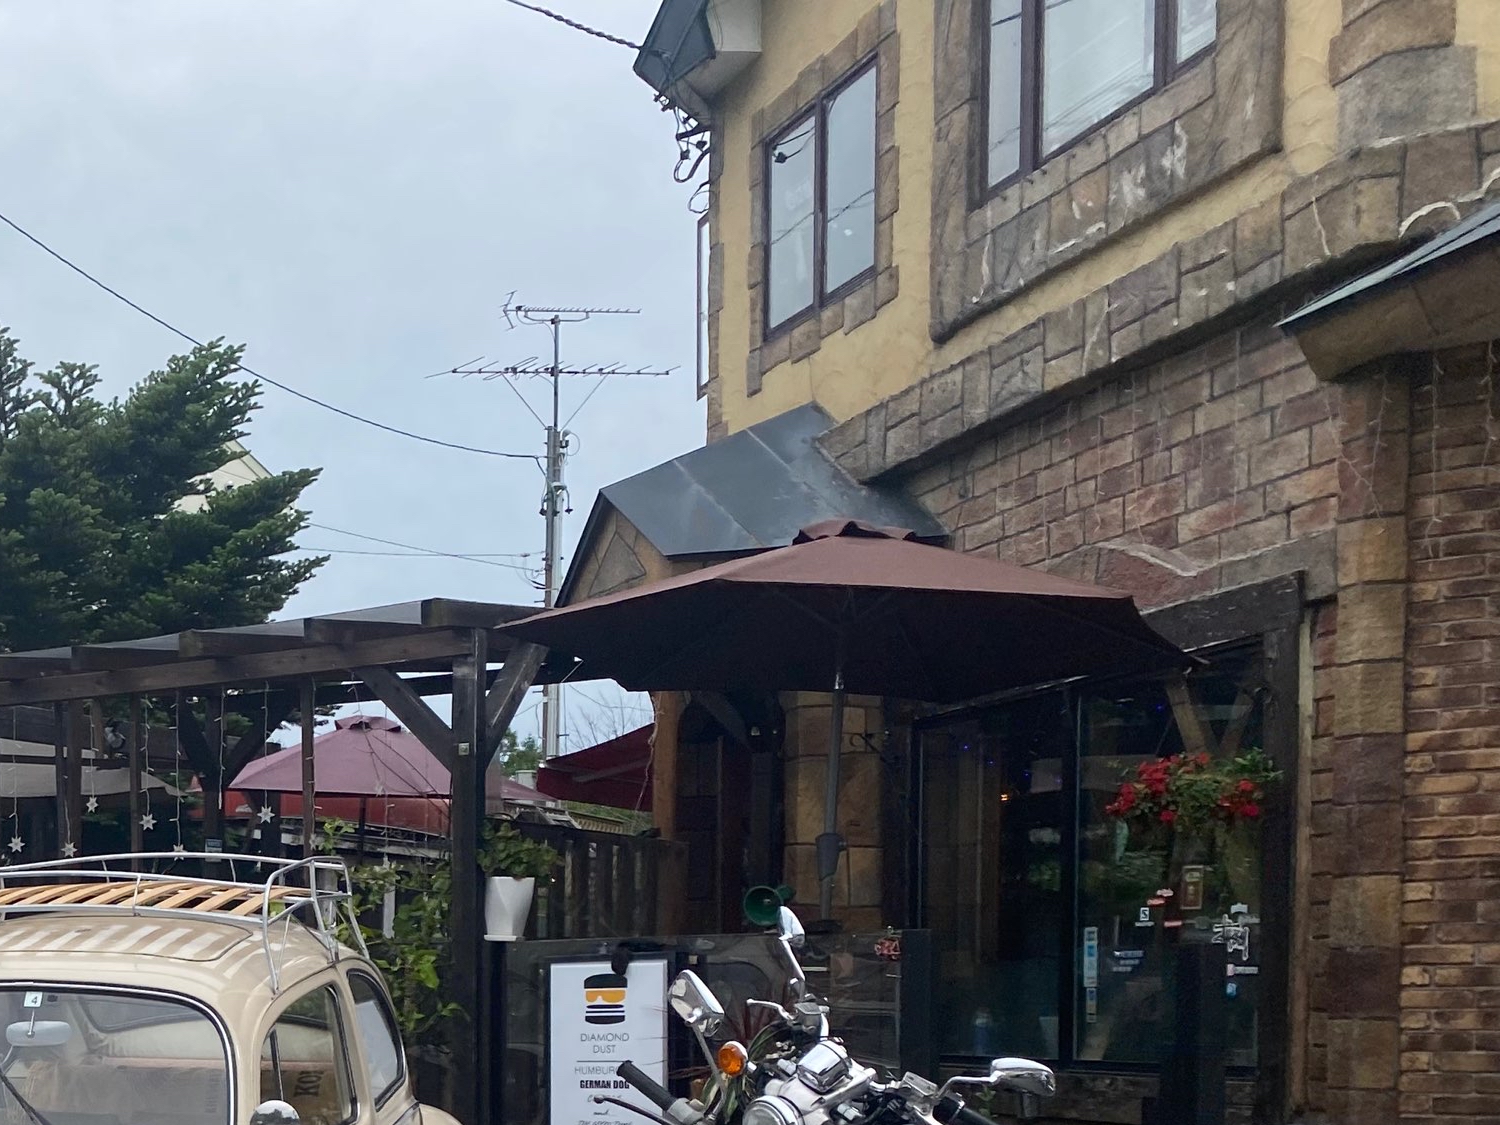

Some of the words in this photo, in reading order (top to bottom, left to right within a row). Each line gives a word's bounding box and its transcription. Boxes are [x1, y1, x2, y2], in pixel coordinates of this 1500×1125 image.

[580, 1032, 630, 1042] DIAMOND
[593, 1045, 616, 1053] DUST
[575, 1066, 619, 1075] HUMBUR
[580, 1080, 611, 1089] GERMAN
[613, 1080, 630, 1089] DOG
